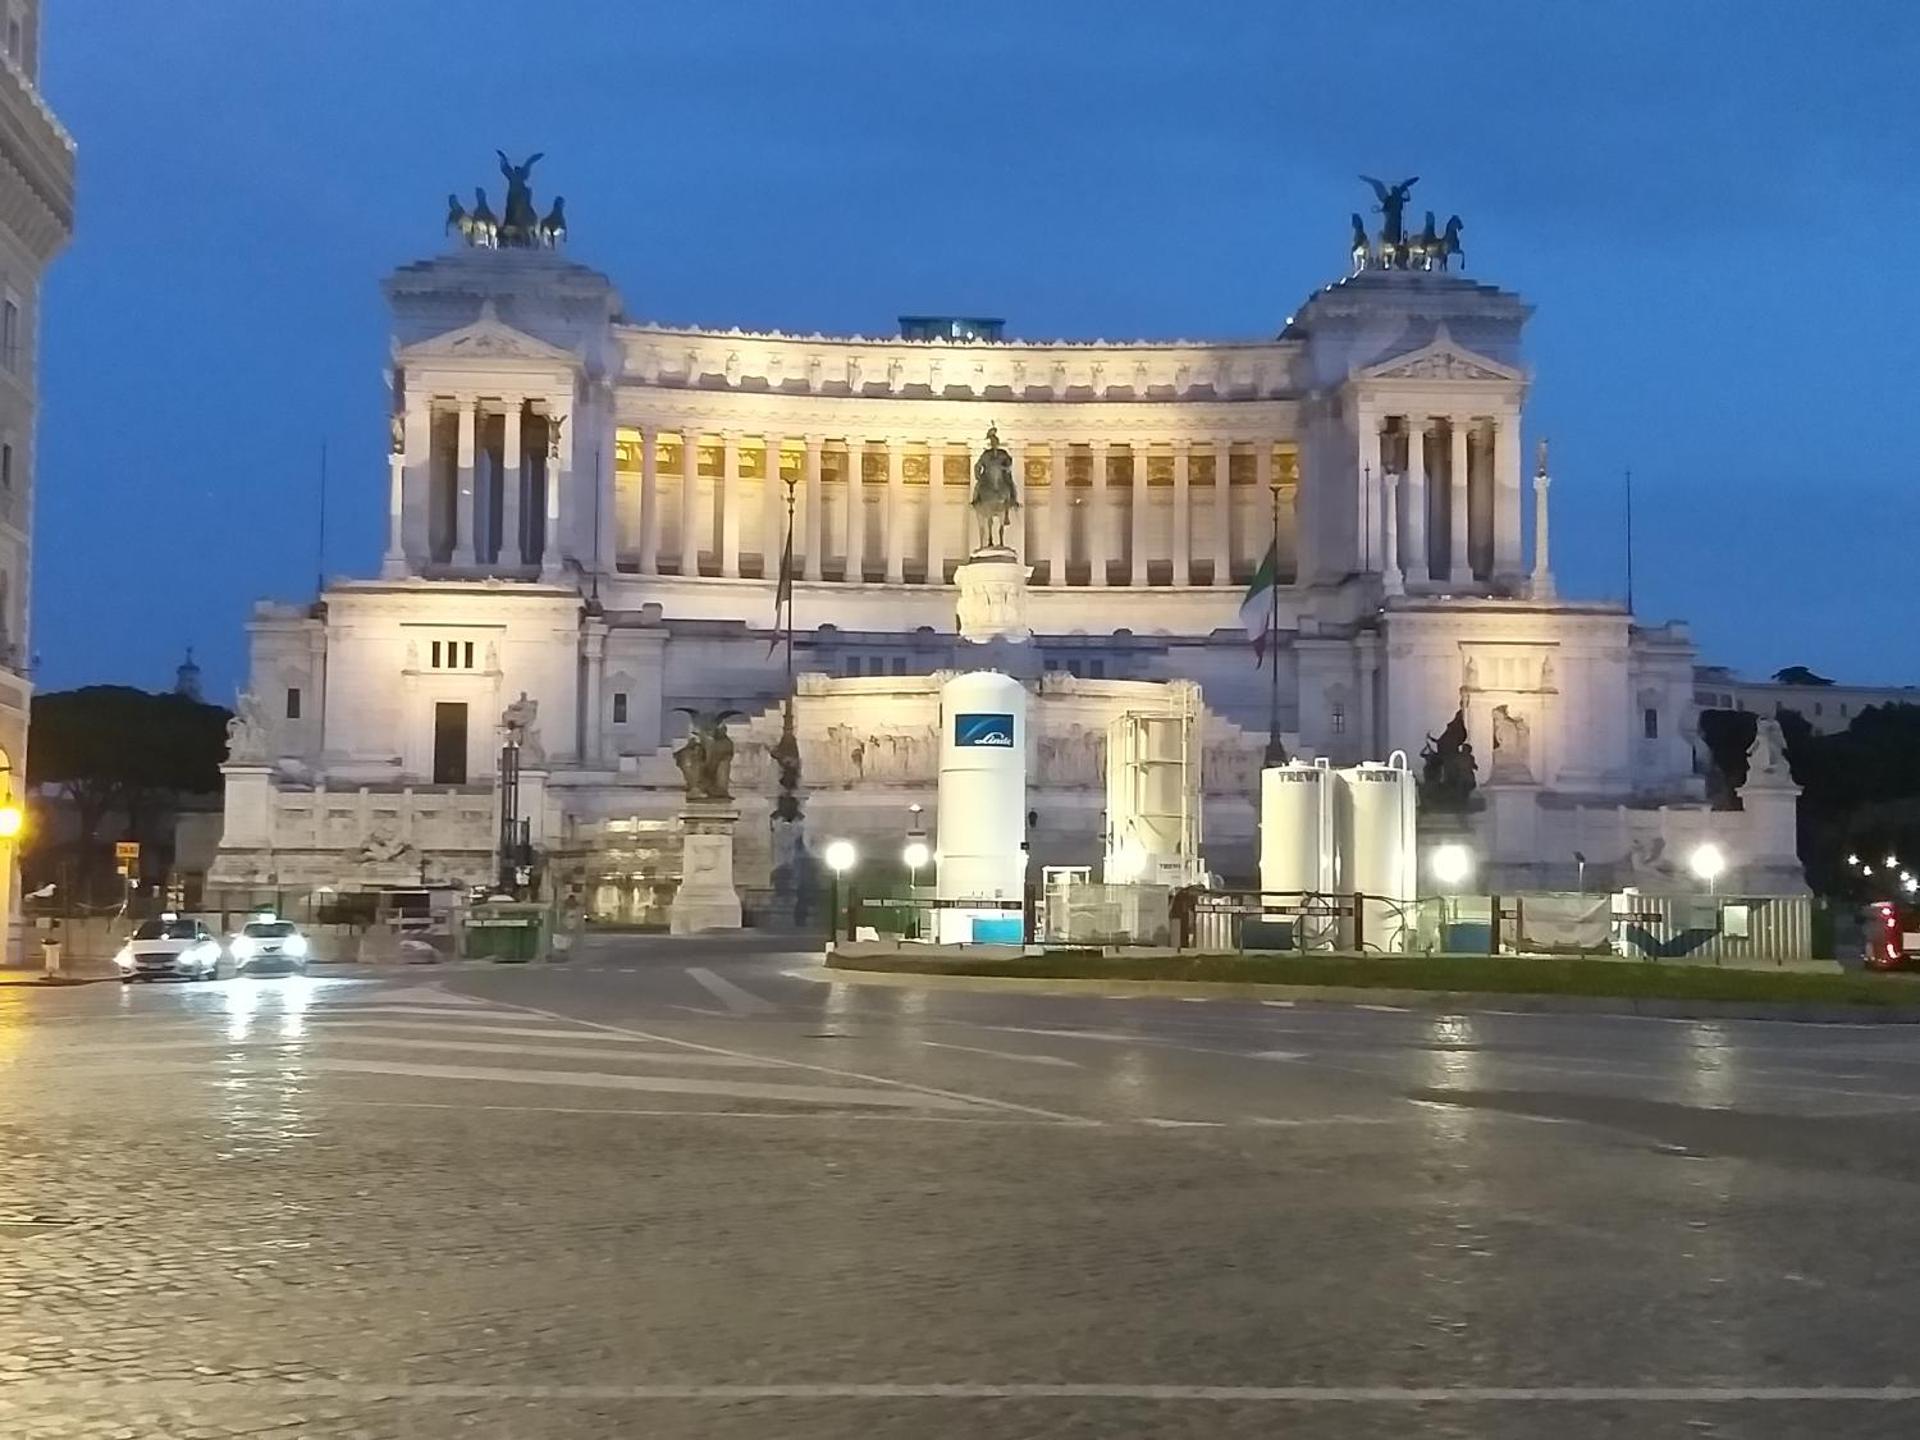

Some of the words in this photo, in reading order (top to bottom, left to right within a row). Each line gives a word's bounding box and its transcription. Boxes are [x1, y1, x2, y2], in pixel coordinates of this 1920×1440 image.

[974, 731, 1011, 745] Linde
[1279, 771, 1319, 783] TREVI
[1357, 770, 1397, 783] TREVI
